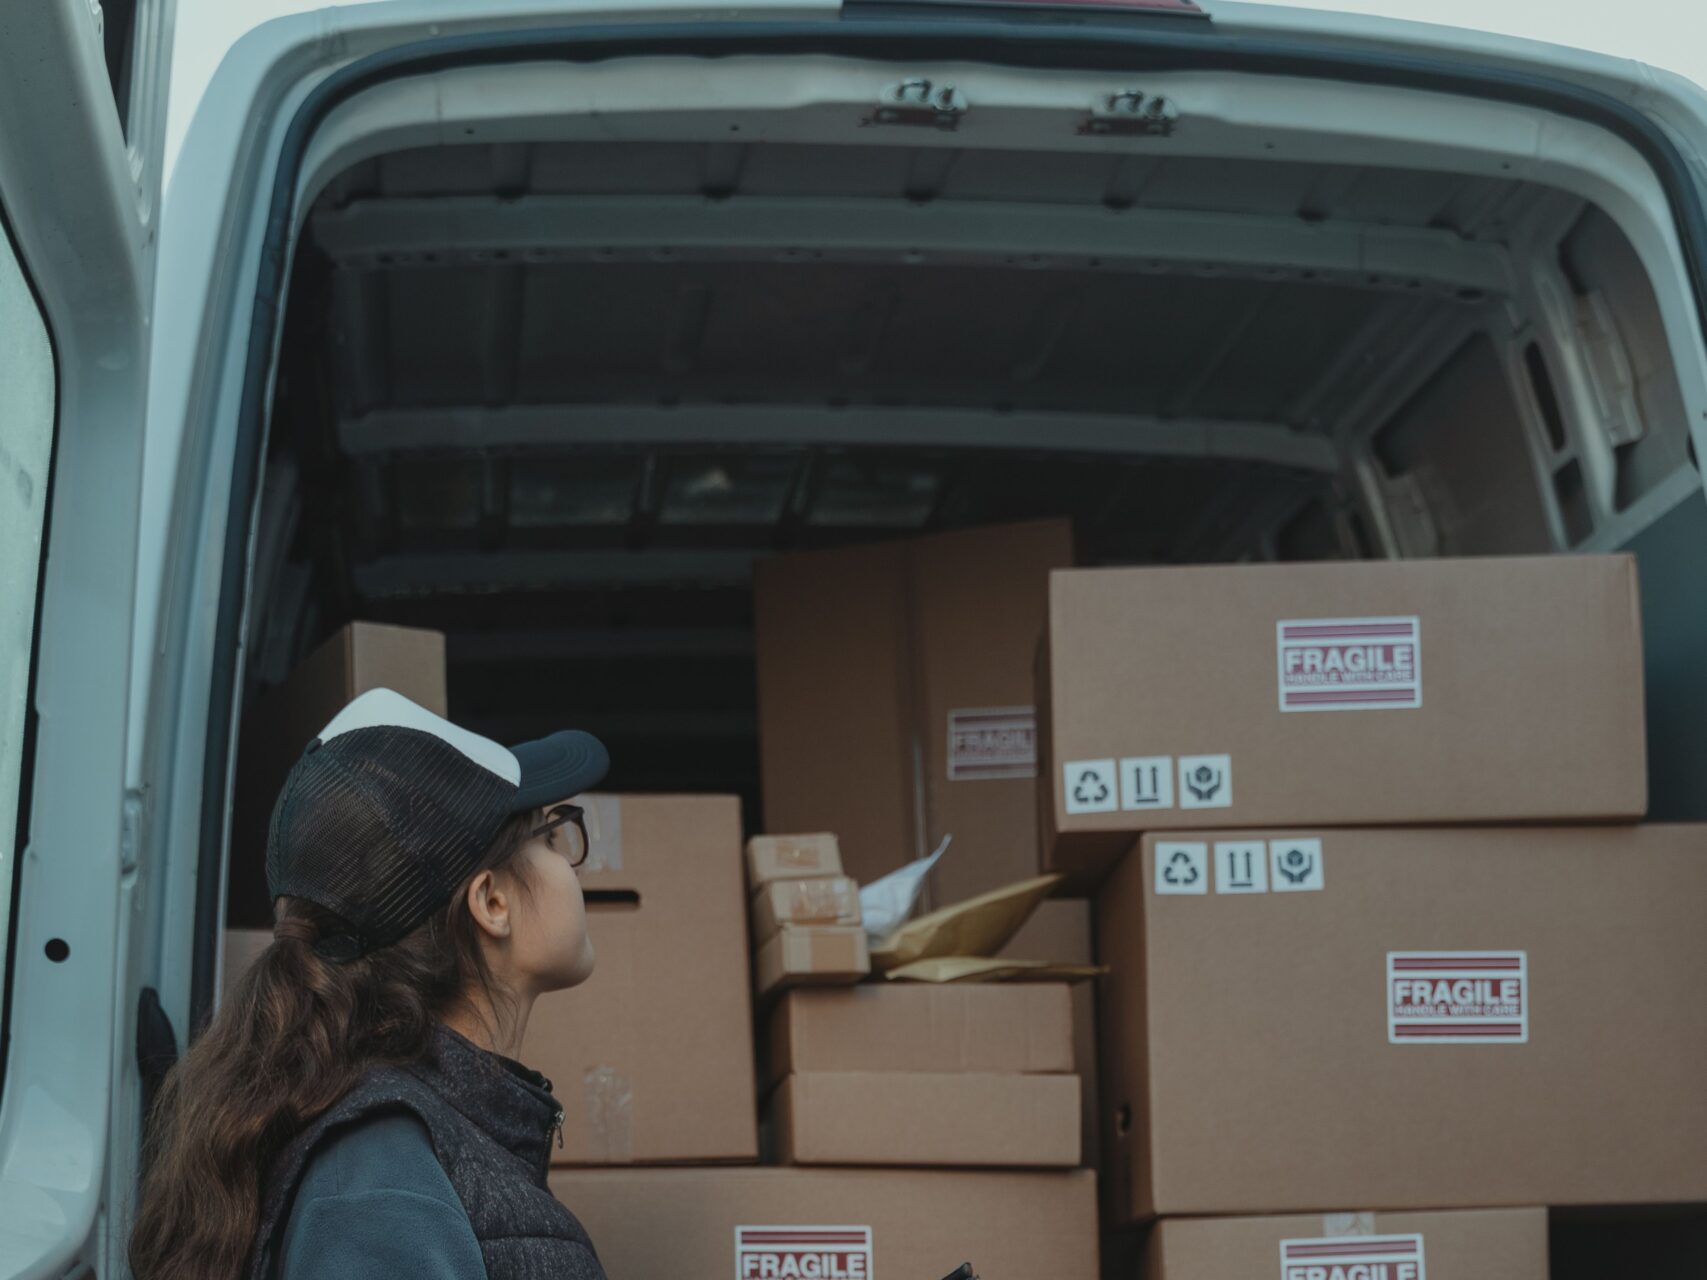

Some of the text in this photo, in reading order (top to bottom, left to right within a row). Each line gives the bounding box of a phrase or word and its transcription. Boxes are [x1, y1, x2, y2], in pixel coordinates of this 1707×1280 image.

[1285, 645, 1412, 674] FRAGILE
[1394, 980, 1519, 1006] FRAGILE
[743, 1253, 865, 1279] FRAGILE
